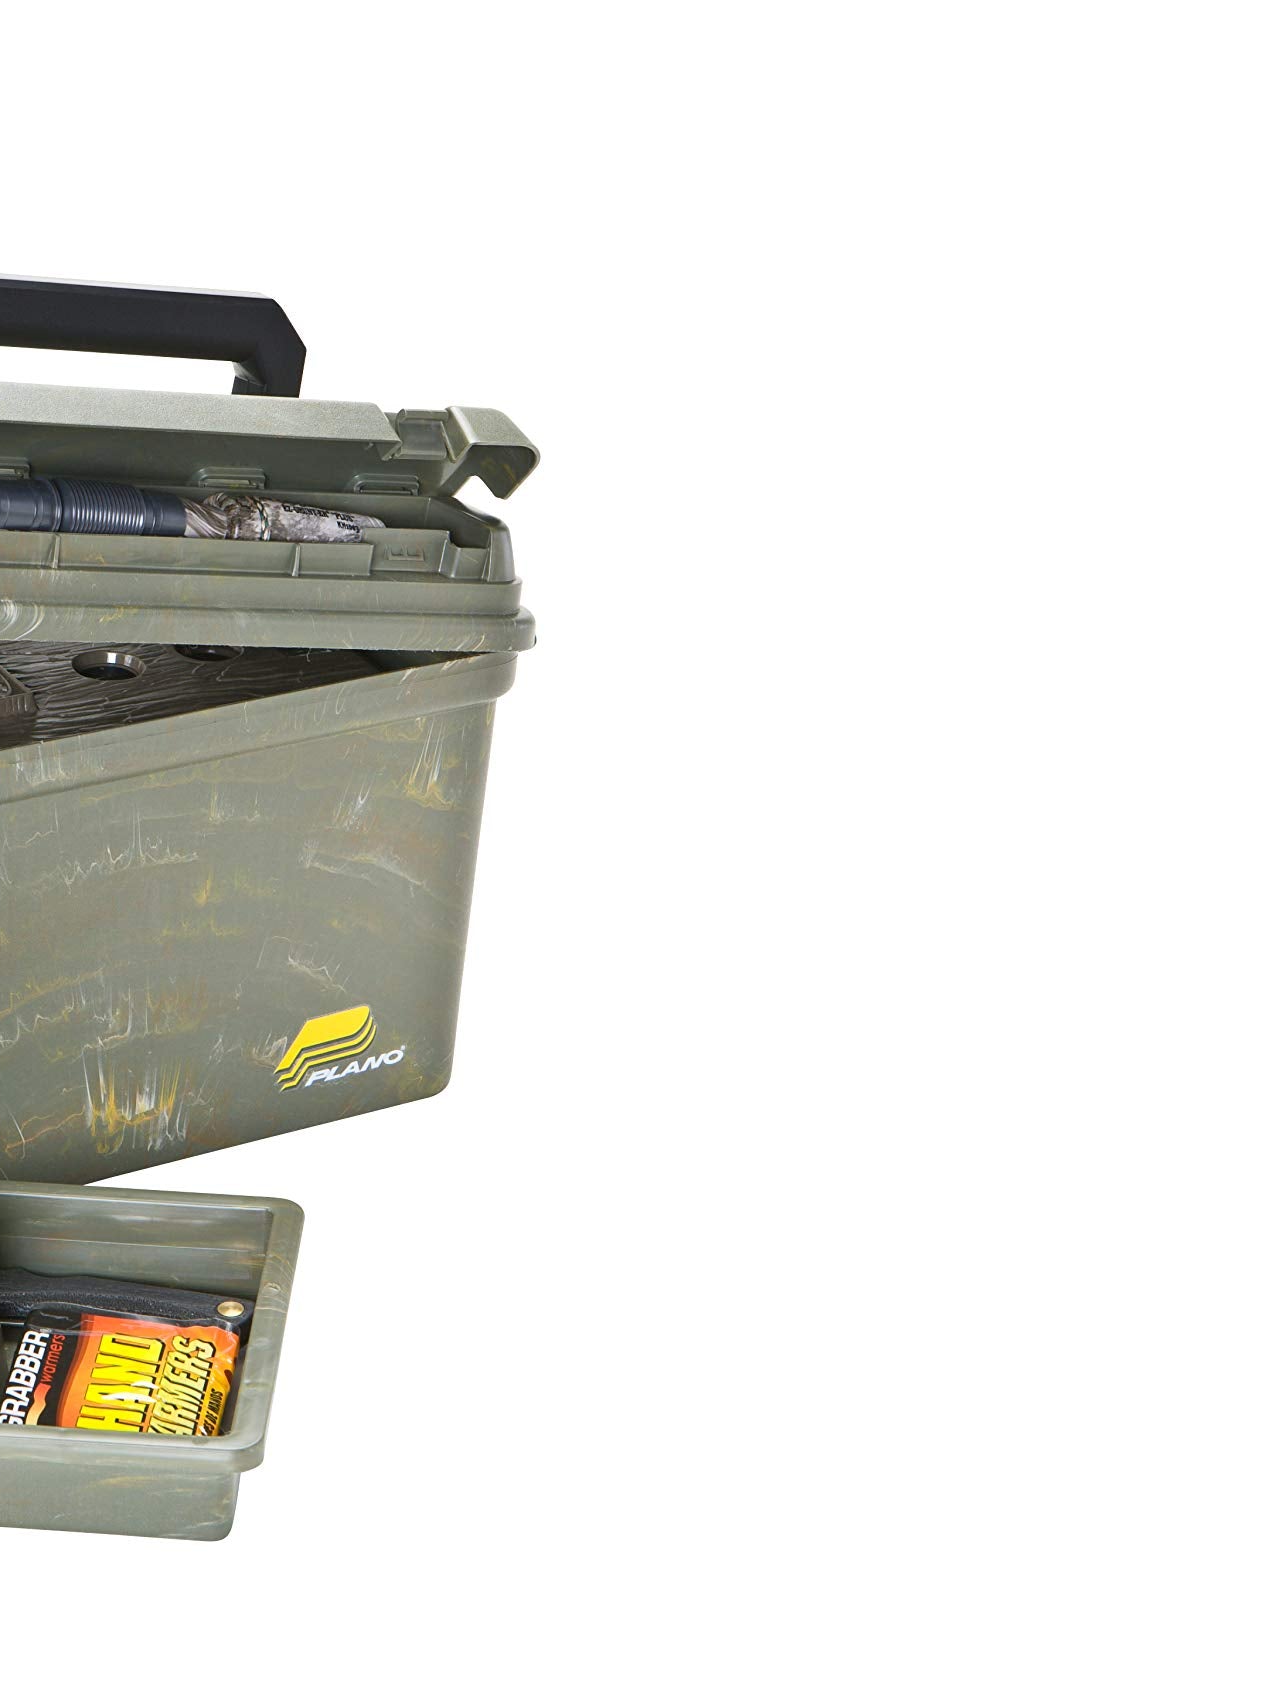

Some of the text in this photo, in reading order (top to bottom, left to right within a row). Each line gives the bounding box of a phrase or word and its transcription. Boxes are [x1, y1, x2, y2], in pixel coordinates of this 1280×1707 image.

[305, 1049, 405, 1087] PLANO
[40, 1334, 66, 1384] warmers
[76, 1333, 166, 1432] HAND
[148, 1335, 216, 1435] ARMERS
